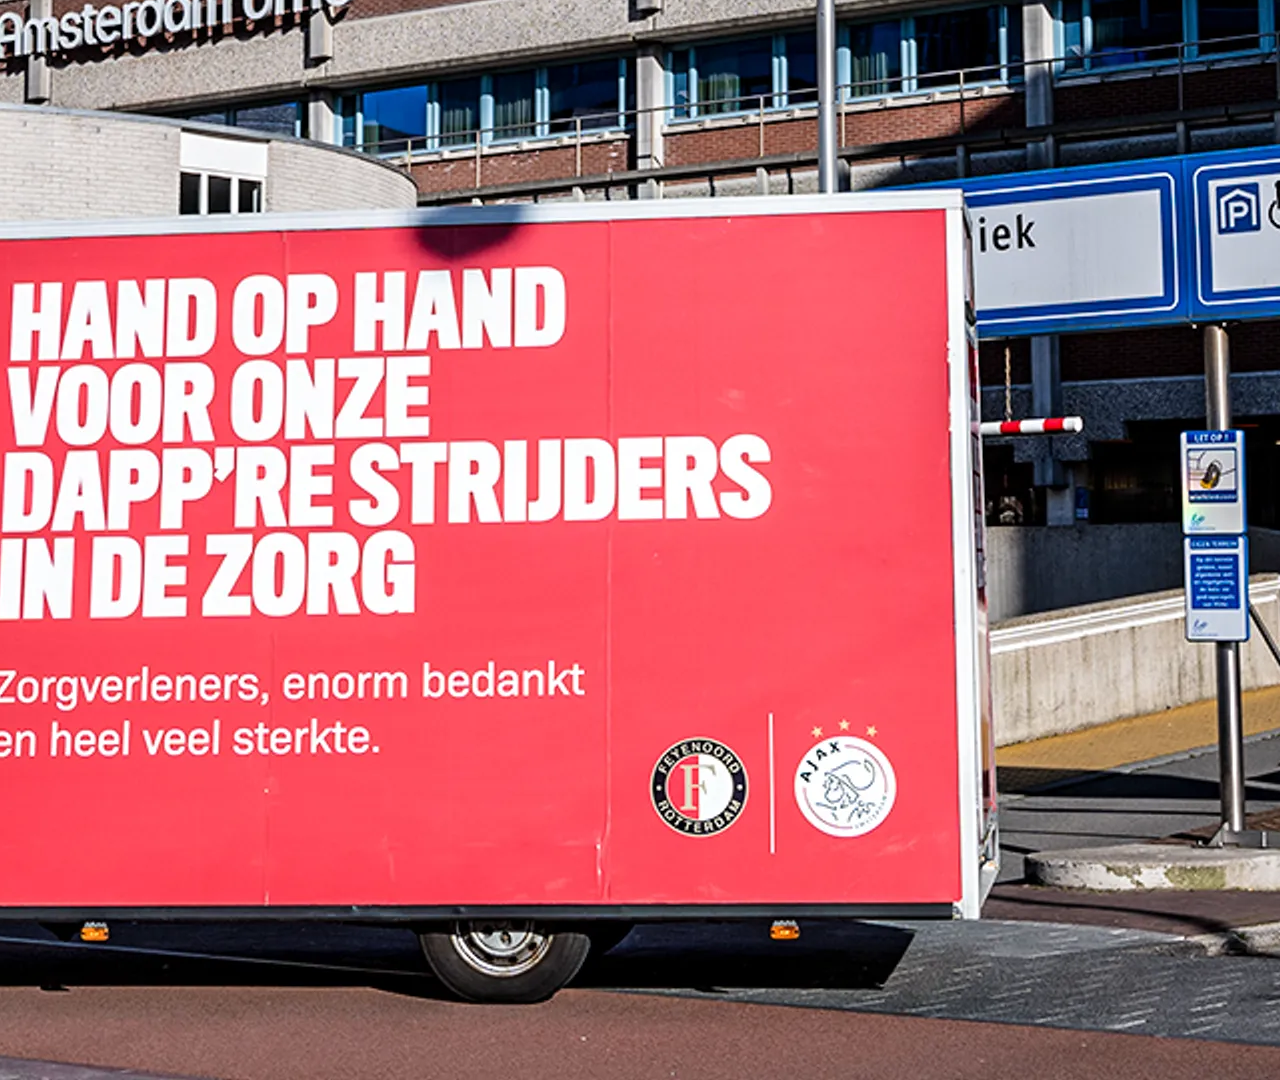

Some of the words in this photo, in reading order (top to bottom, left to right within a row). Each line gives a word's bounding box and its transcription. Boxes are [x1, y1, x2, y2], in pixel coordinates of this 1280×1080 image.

[8, 277, 217, 362] HAND
[231, 272, 339, 356] OP
[353, 265, 566, 352] HAND
[7, 362, 216, 447] VOOR
[230, 356, 431, 442] ONZE
[1, 444, 335, 534] DAPP'RE
[348, 433, 773, 527] STRIJDERS
[90, 534, 189, 620] DE
[201, 530, 417, 618] ZORG
[283, 671, 409, 700] enorm
[422, 660, 586, 699] bedankt
[50, 720, 130, 757] heel
[142, 719, 220, 756] veel
[233, 718, 381, 755] sterkte.
[657, 740, 741, 775] FEYENOORD
[799, 740, 841, 783] AJAX
[657, 799, 742, 834] ROTTERDAM
